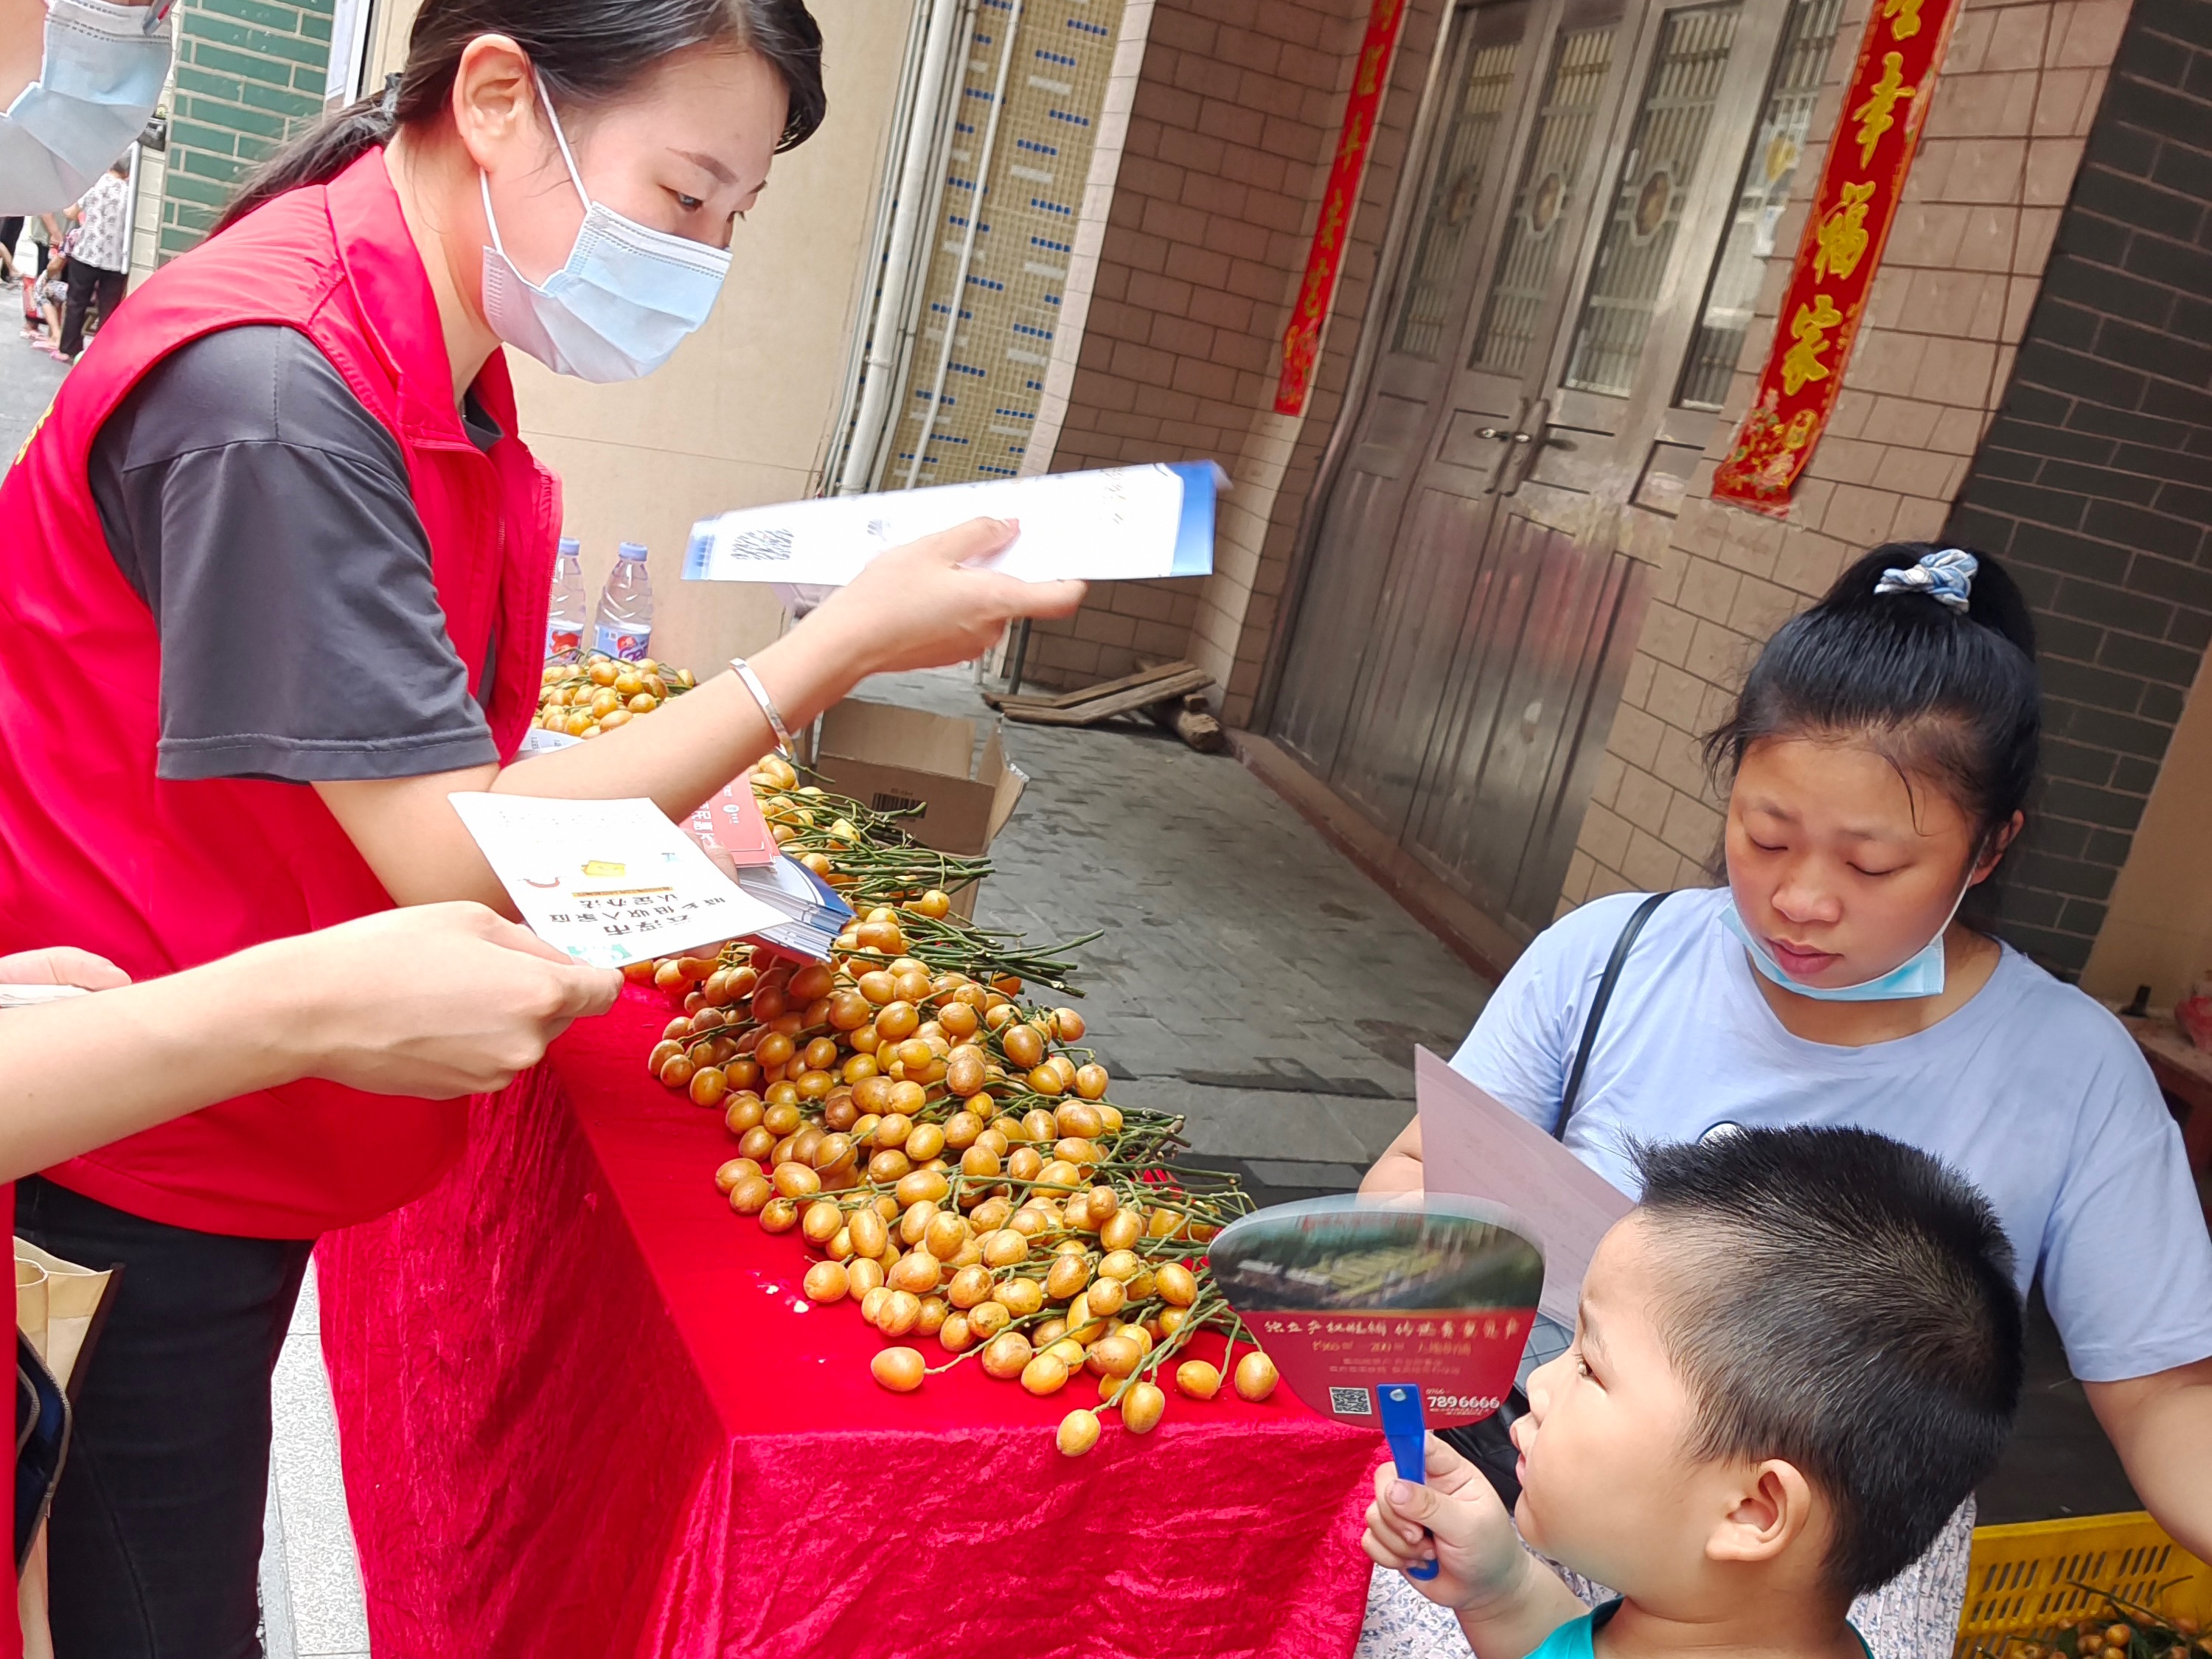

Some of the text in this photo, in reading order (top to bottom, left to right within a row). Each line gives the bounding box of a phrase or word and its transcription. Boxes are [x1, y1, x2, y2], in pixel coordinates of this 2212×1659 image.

[549, 897, 726, 922] 城乡低收入家庭
[579, 894, 678, 908] 认定办法
[603, 914, 692, 936] 云浮市
[1427, 1396, 1500, 1409] 7896666
